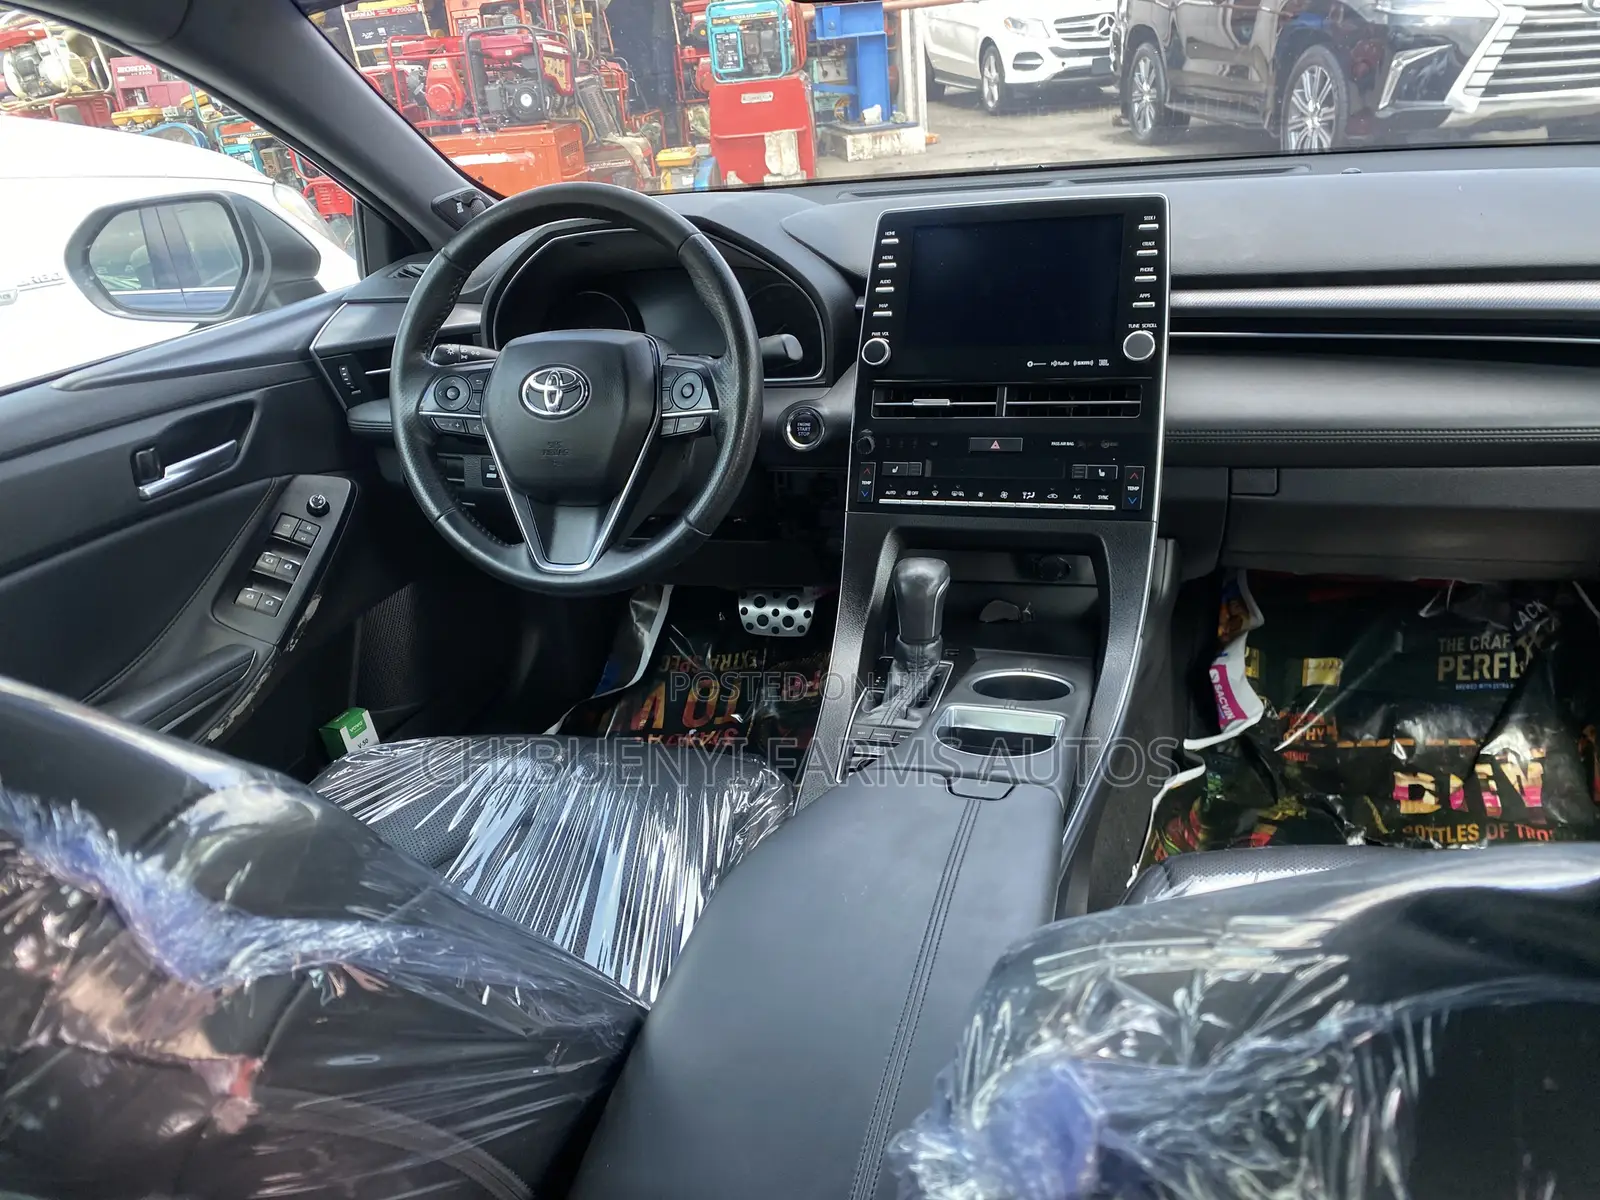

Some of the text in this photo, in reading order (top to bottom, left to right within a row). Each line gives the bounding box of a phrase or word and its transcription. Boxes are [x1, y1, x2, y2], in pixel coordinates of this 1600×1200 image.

[117, 64, 152, 73] HONDA
[1438, 636, 1465, 652] THE
[1214, 683, 1236, 720] SACVIN
[1486, 823, 1510, 840] OF
